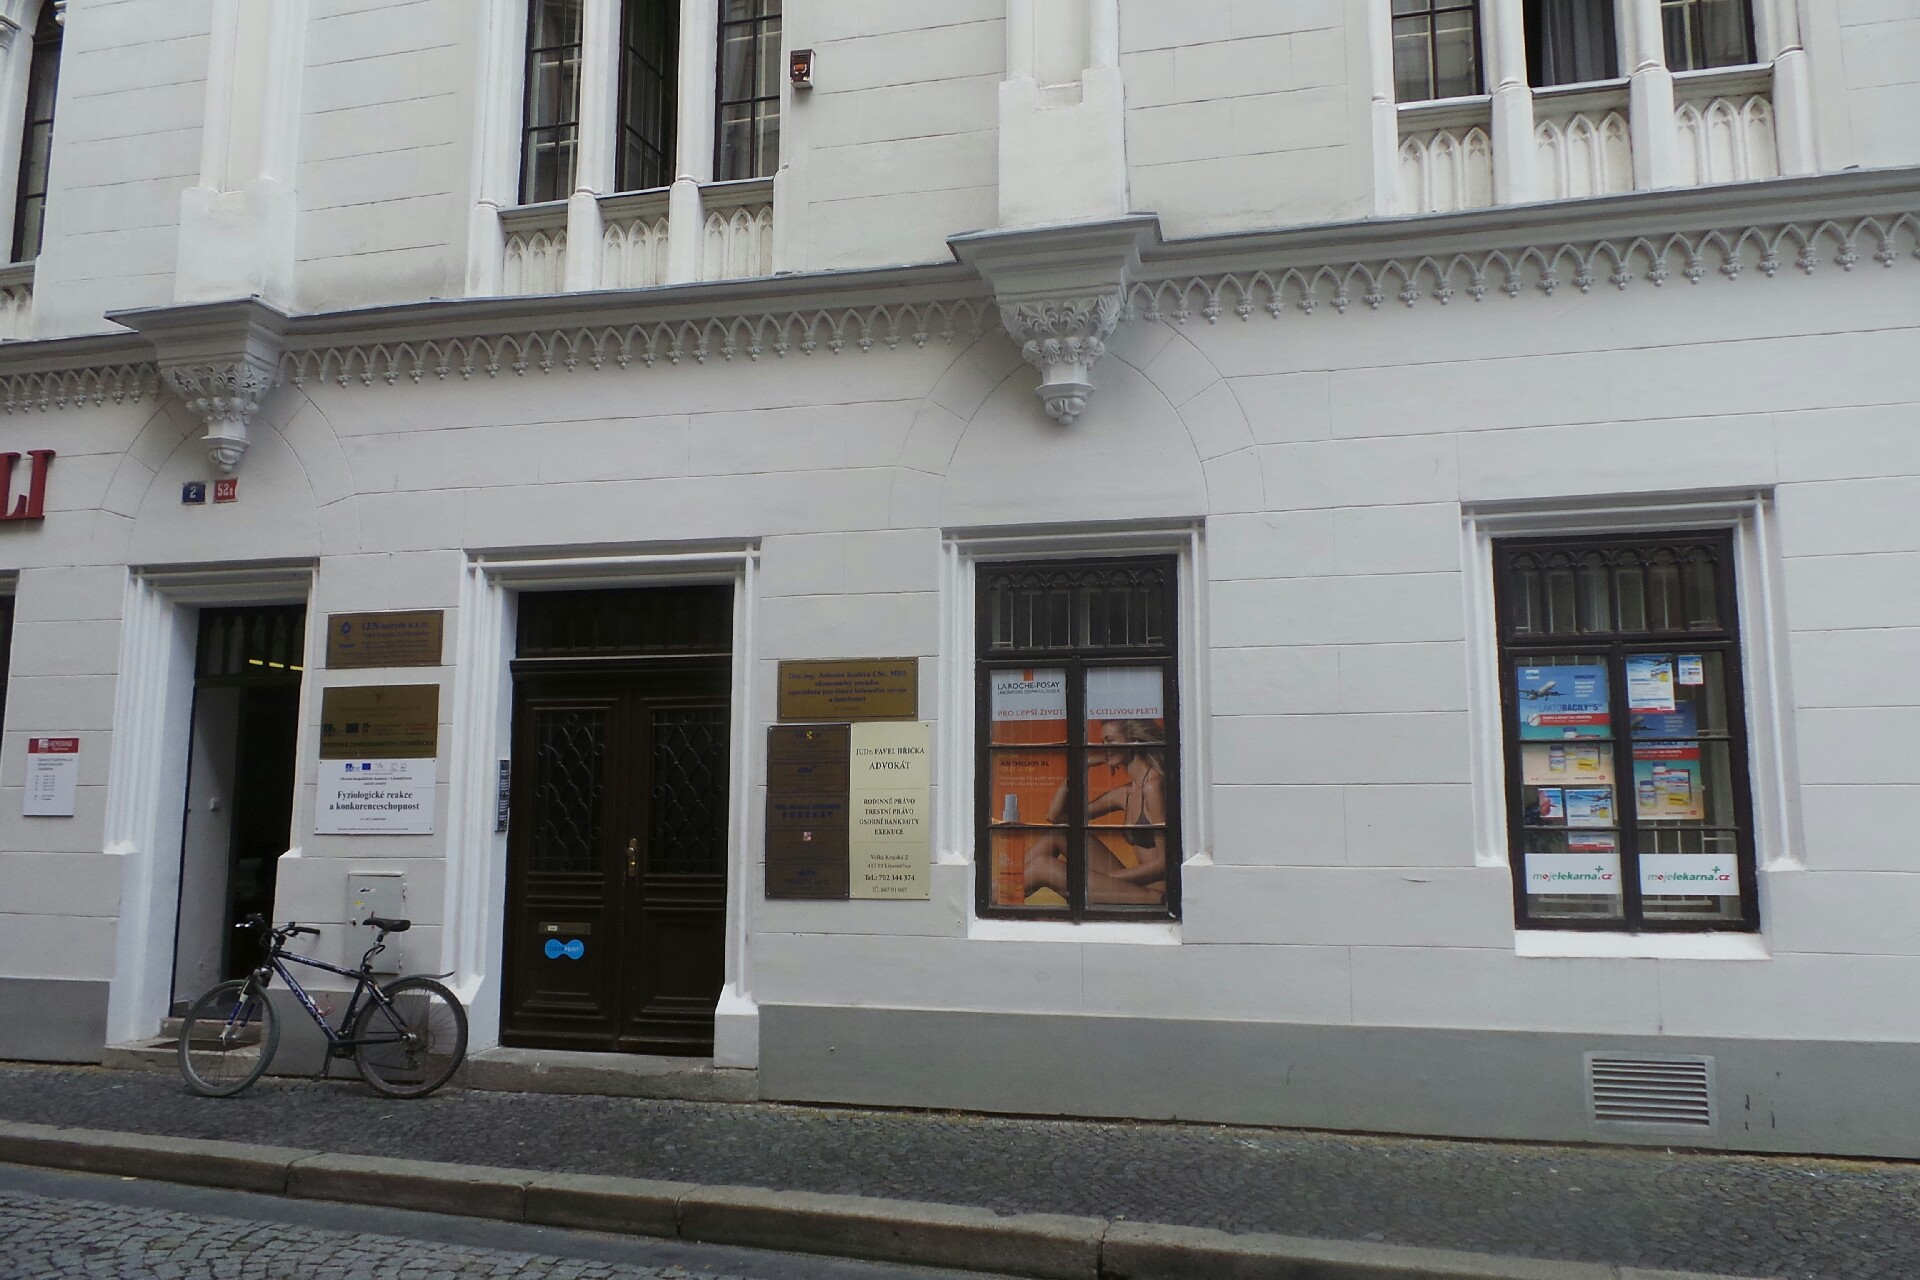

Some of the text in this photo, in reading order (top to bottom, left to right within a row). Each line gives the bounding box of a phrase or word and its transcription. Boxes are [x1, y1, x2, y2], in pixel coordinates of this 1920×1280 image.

[189, 485, 197, 499] 2
[1039, 708, 1064, 716] ŽIVOT
[869, 760, 911, 770] ADVOKÁT
[337, 790, 413, 801] Fyziologické reakce
[863, 797, 916, 805] RODINNÉ PRÁVO
[336, 801, 420, 812] konkurenceschopnost
[864, 807, 914, 815] TRESTNÍ PRÁVO
[859, 817, 884, 825] OSOBNÍ
